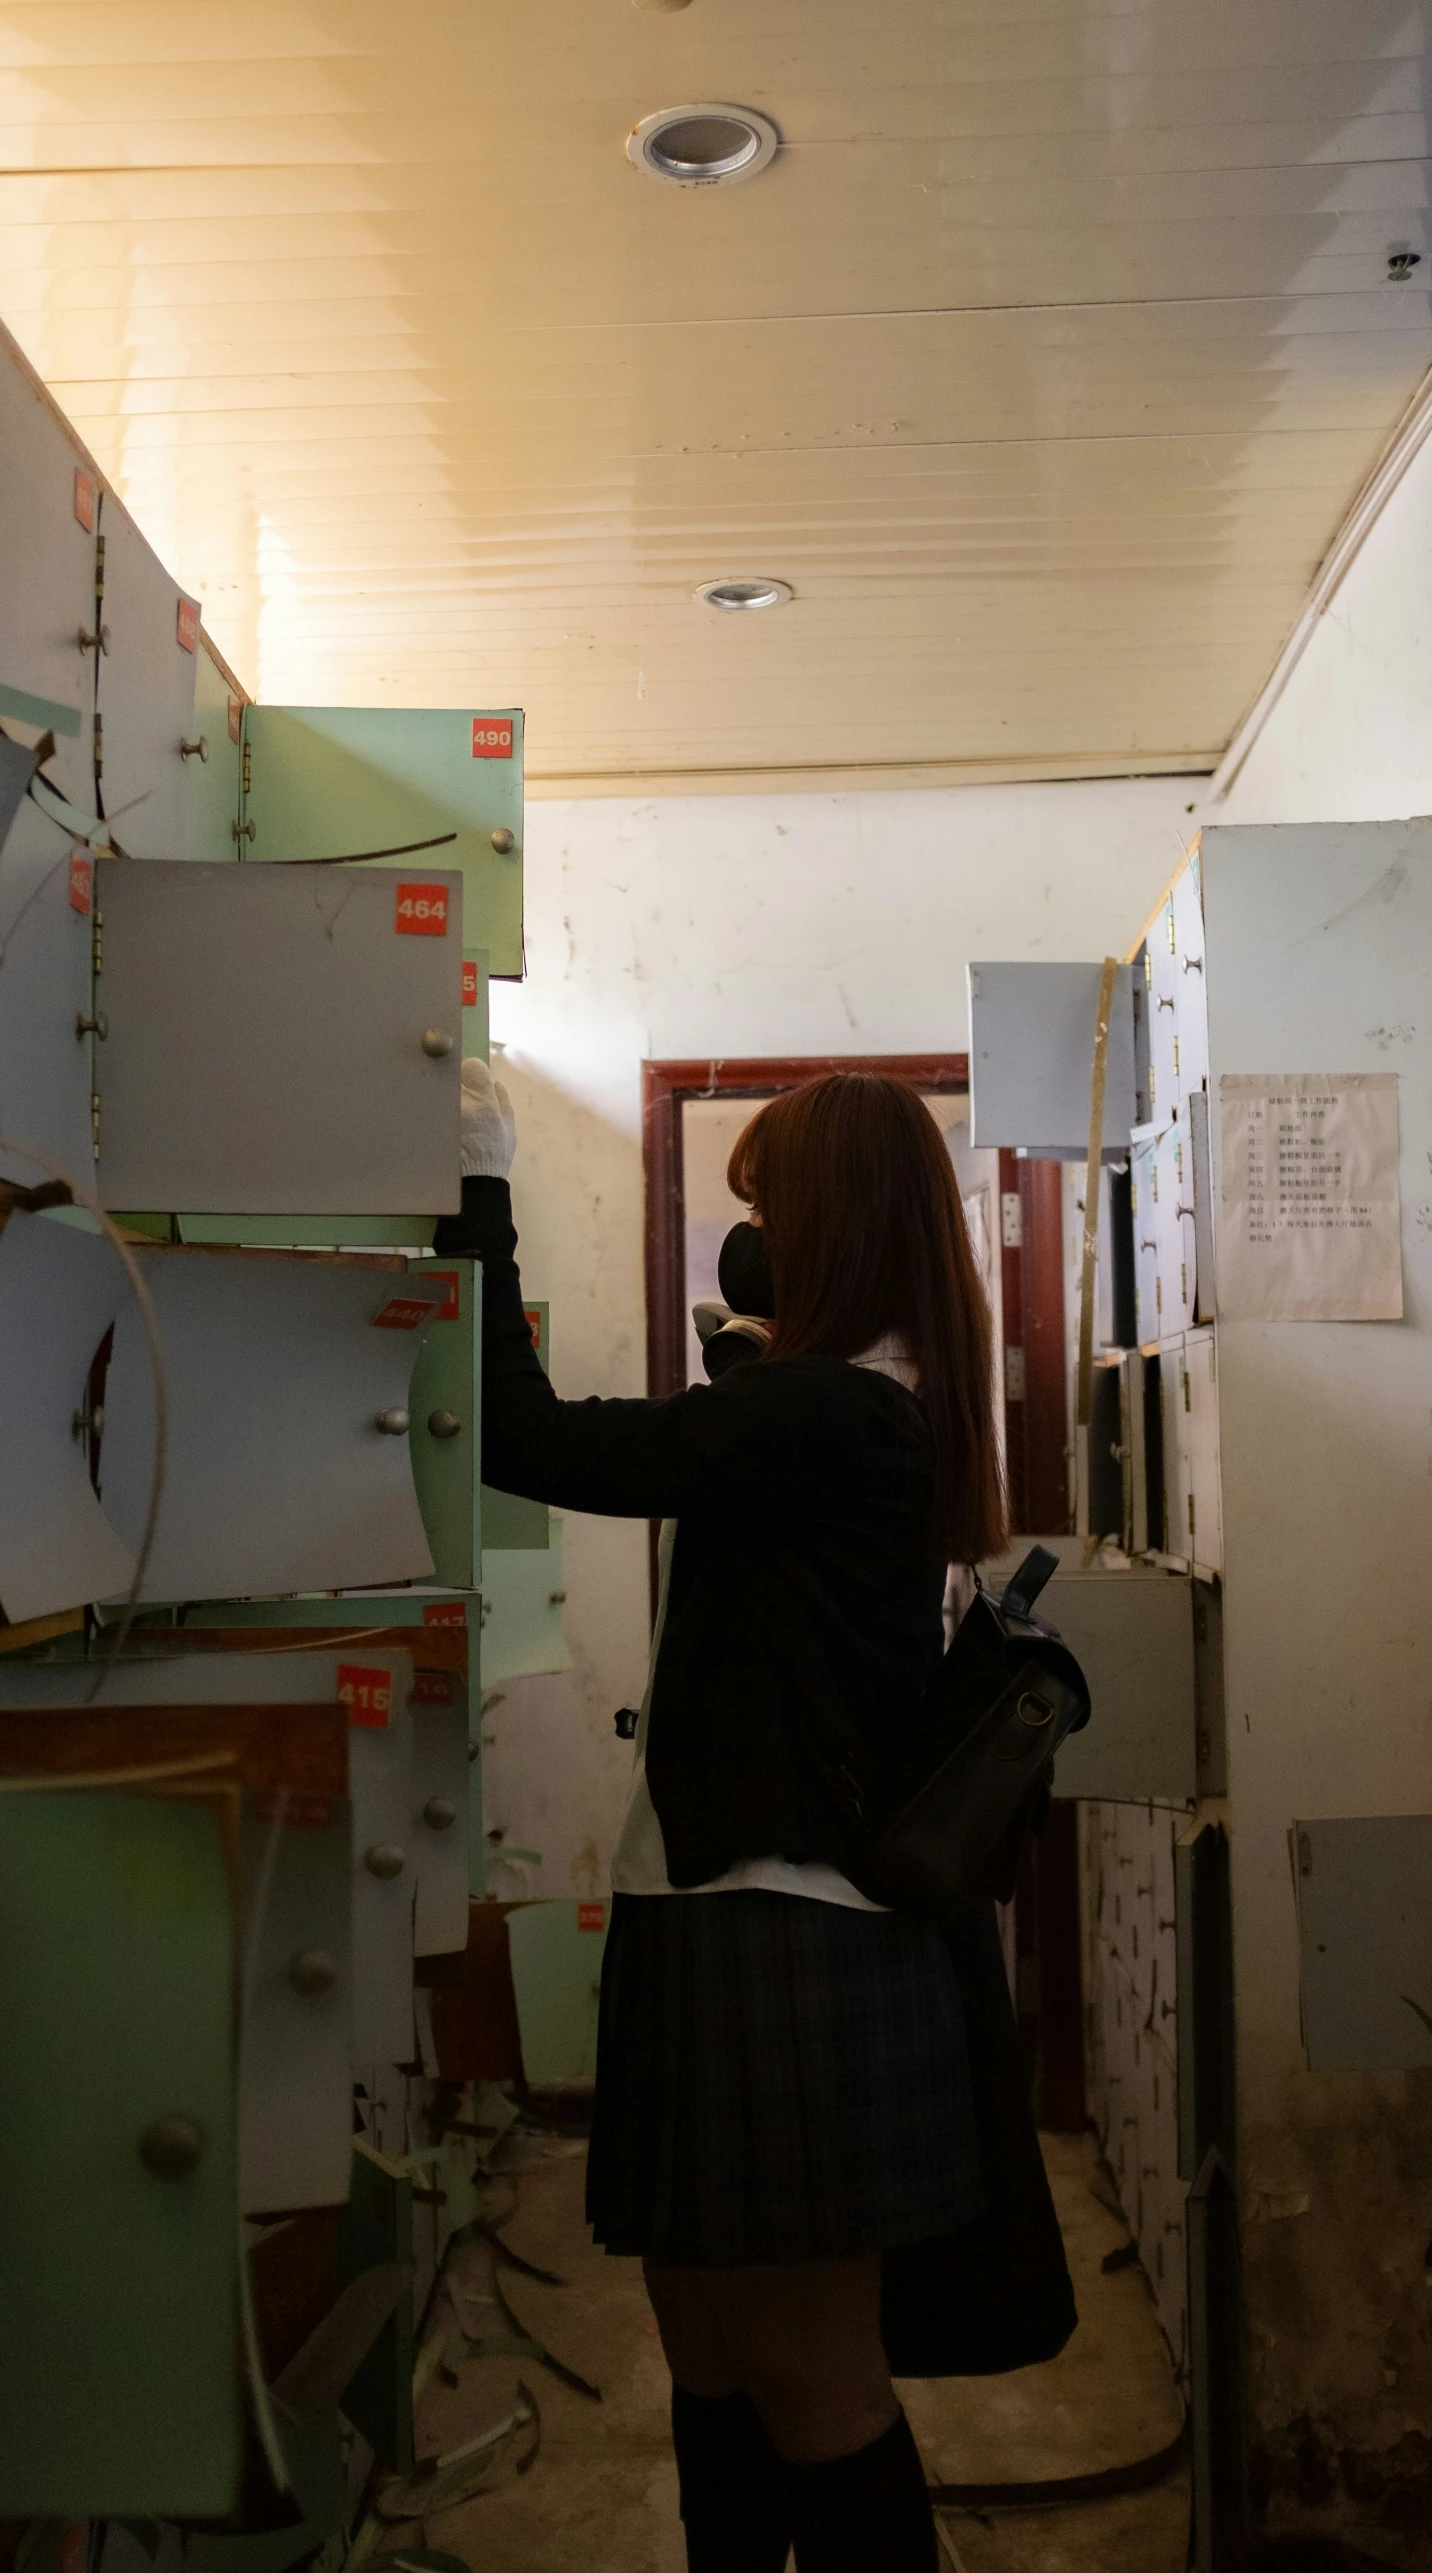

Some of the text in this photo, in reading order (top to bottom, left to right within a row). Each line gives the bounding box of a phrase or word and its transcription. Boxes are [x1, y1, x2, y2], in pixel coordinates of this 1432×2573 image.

[473, 730, 511, 746] 490
[397, 898, 446, 920] 464
[1248, 1125, 1263, 1133] 周一
[1248, 1138, 1264, 1146] 周二
[1248, 1152, 1264, 1160] 周三
[1248, 1179, 1264, 1187] 周五
[1249, 1193, 1264, 1201] 周六
[1249, 1206, 1264, 1215] 周日
[416, 1682, 448, 1695] 16
[338, 1683, 390, 1711] 415
